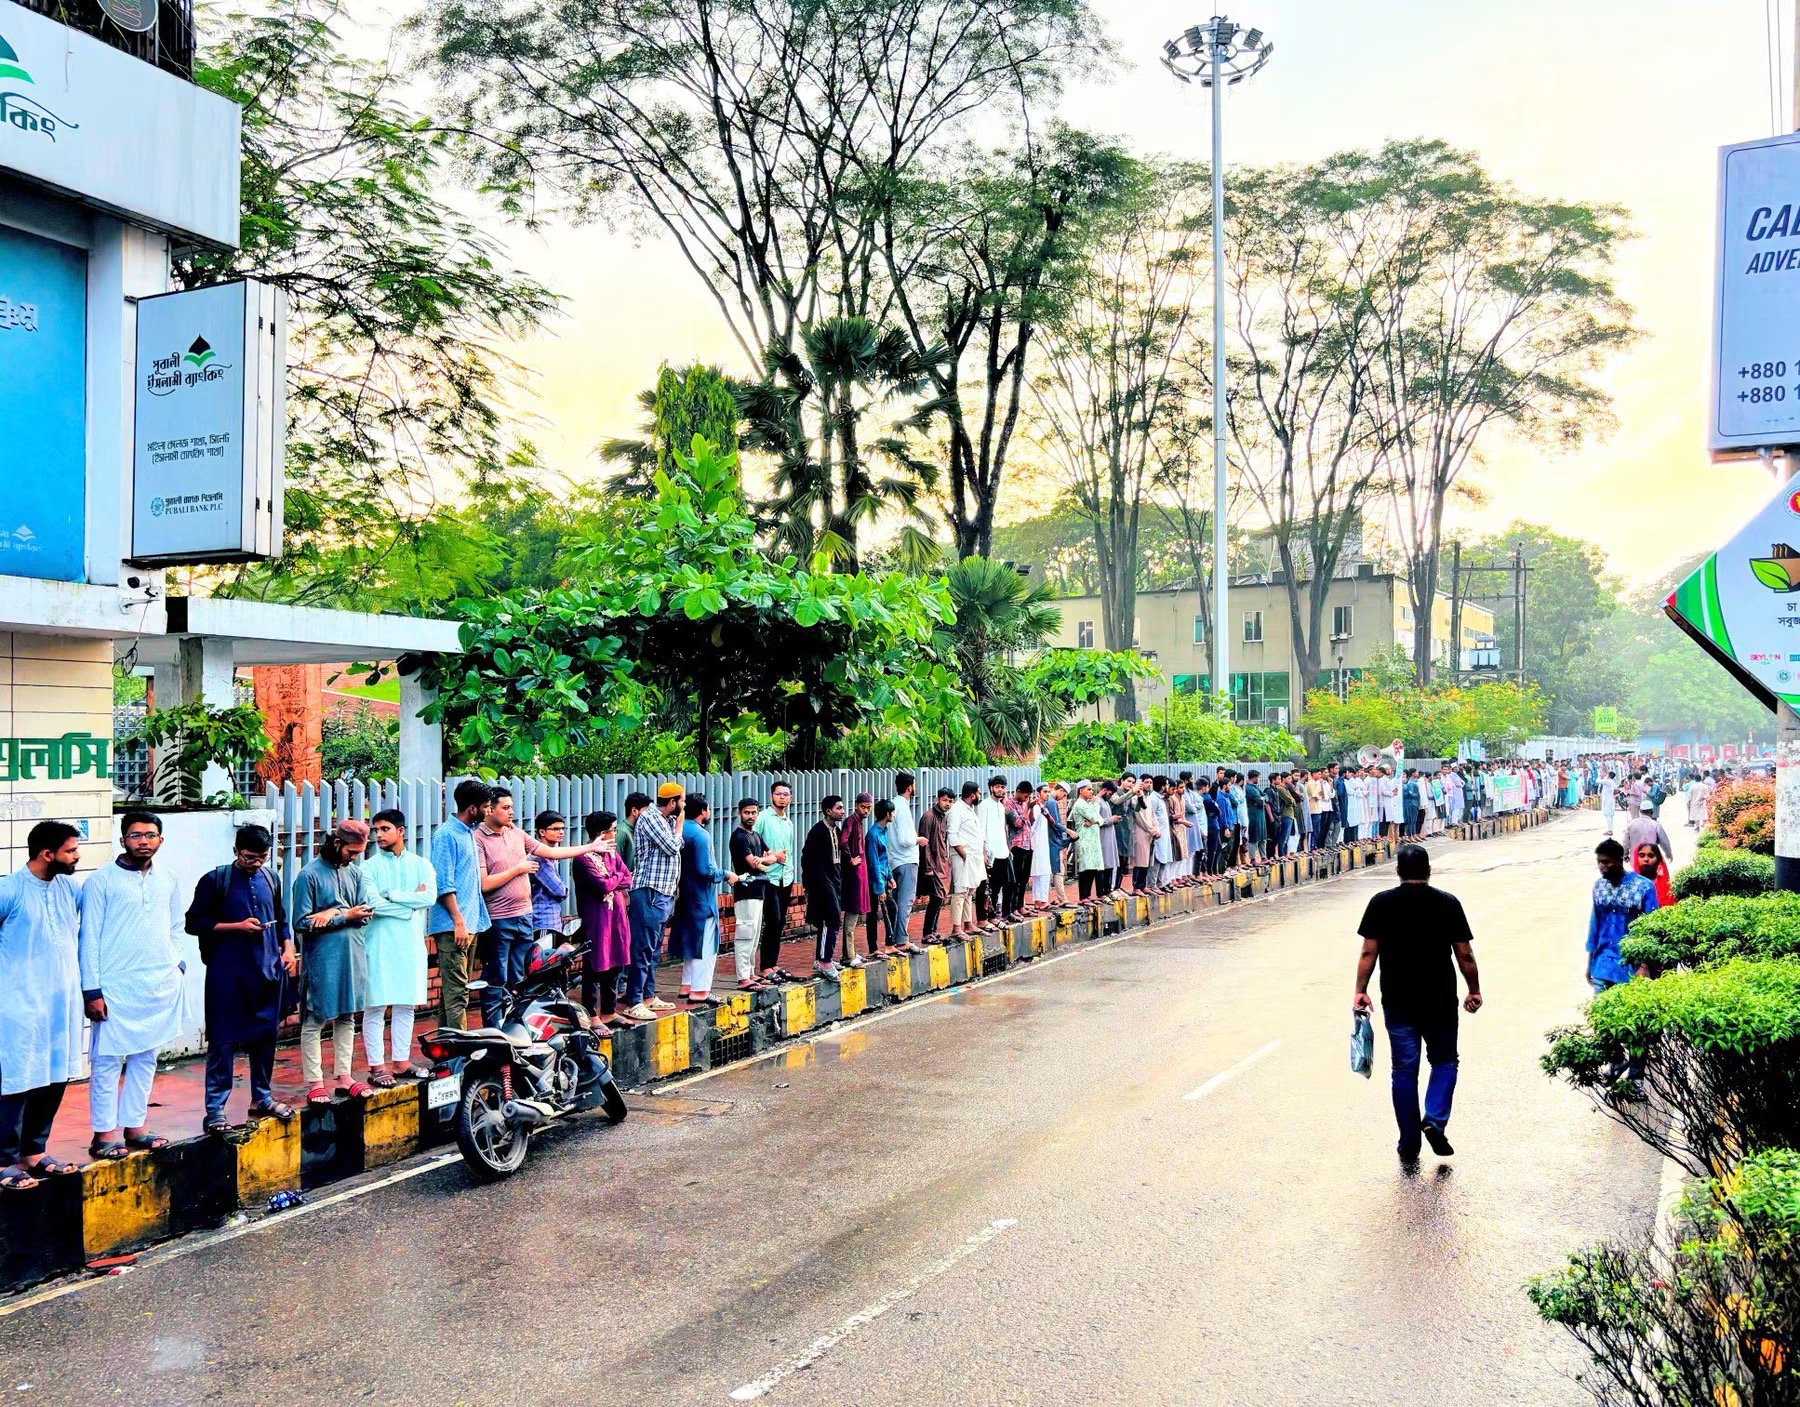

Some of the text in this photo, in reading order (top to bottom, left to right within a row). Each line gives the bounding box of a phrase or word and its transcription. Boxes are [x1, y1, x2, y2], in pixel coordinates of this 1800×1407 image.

[1745, 247, 1800, 275] ADVE
[185, 364, 232, 388] ব্যাংকিং
[1738, 361, 1786, 379] +880
[1737, 385, 1785, 404] +880
[165, 503, 224, 515] PUBALI BANK PLC
[1786, 602, 1797, 612] চা
[1750, 653, 1781, 661] SEYLN
[1597, 716, 1614, 724] ATM
